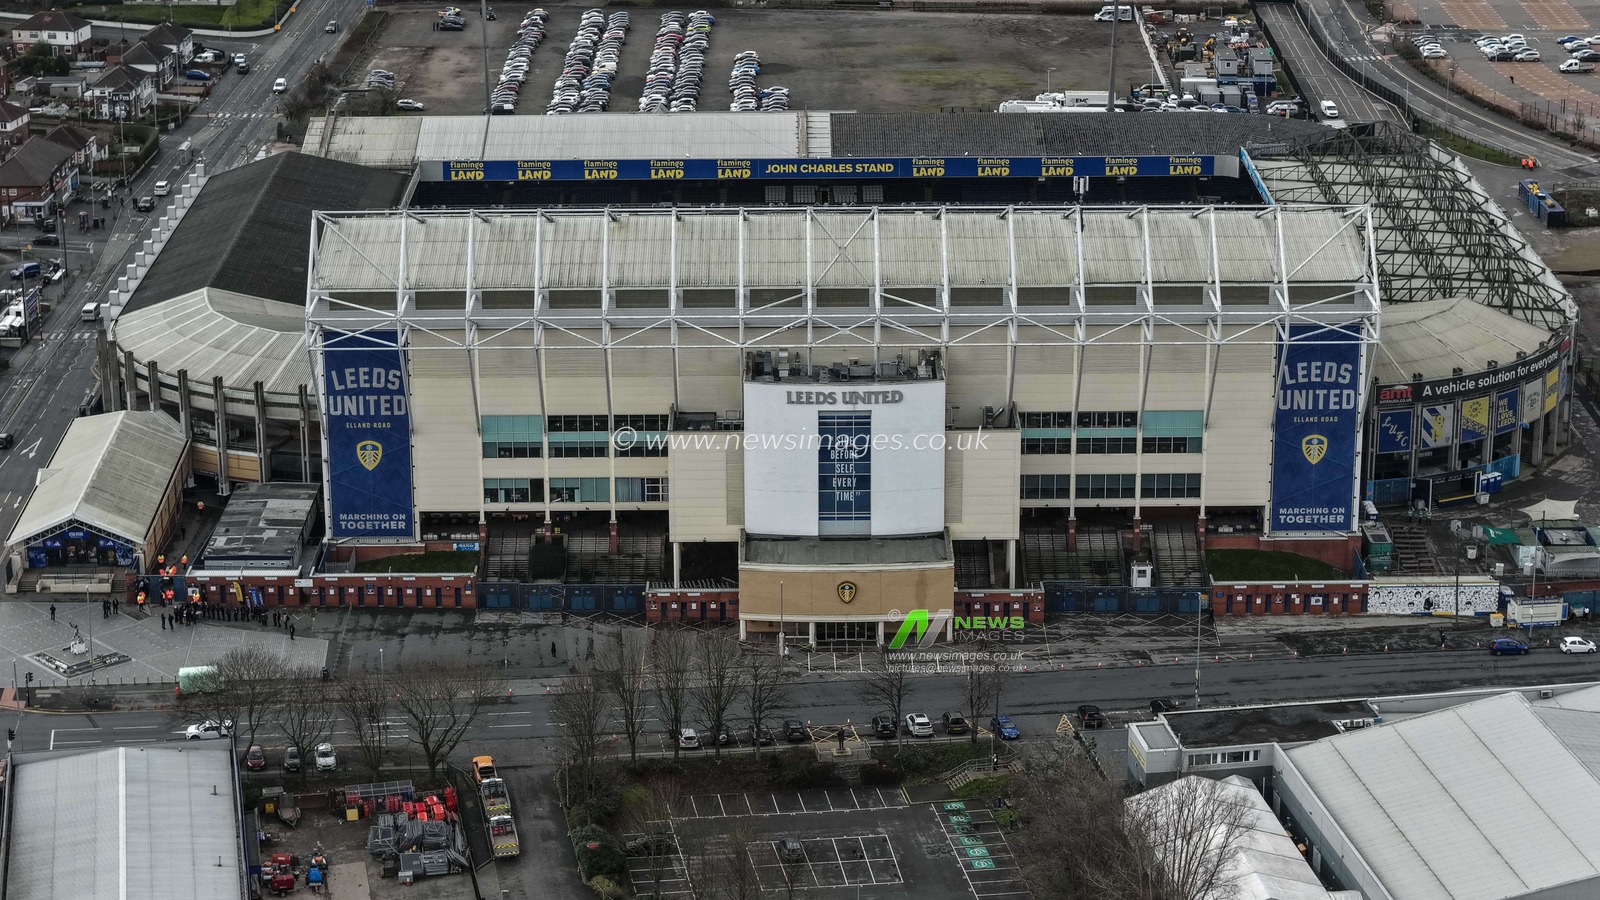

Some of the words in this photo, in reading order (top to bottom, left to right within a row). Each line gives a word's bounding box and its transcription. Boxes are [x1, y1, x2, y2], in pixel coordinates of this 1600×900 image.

[517, 160, 551, 169] flamingo
[584, 160, 617, 168] flamingo
[650, 159, 683, 168] flamingo
[717, 159, 750, 168] flamingo
[912, 158, 944, 166] flamingo
[977, 158, 1009, 166] flamingo
[1041, 157, 1073, 166] flamingo
[1105, 157, 1137, 165] flamingo
[1169, 156, 1201, 165] flamingo
[450, 161, 484, 170] flamingo
[766, 164, 797, 173] JOHN
[801, 164, 852, 172] CHARLES
[856, 164, 894, 172] STAND
[451, 170, 485, 180] LAND
[518, 170, 552, 179] LAND
[585, 170, 618, 179] LAND
[651, 169, 684, 178] LAND
[718, 169, 751, 178] LAND
[913, 167, 945, 177] LAND
[978, 167, 1010, 176] LAND
[1042, 167, 1074, 176] LAND
[1106, 166, 1138, 176] LAND
[1170, 166, 1202, 175] LAND
[1283, 362, 1352, 385] LEEDS
[1422, 385, 1432, 397] A
[1435, 380, 1476, 395] vehicle
[1478, 370, 1516, 388] solution
[1517, 366, 1529, 378] for
[1530, 351, 1559, 372] everyone
[331, 368, 401, 391] LEEDS
[786, 390, 838, 405] LEEDS
[841, 390, 904, 404] UNITED
[1380, 386, 1412, 400] amt
[1278, 389, 1355, 410] UNITED
[1499, 398, 1508, 406] WE
[329, 396, 406, 416] UNITED
[1498, 405, 1508, 414] ALL
[1498, 410, 1513, 420] LOVE
[1497, 416, 1516, 428] LEEDS
[830, 450, 858, 460] BEFORE
[836, 464, 856, 474] SELF,
[832, 478, 857, 488] EVERY
[1279, 515, 1344, 524] TOGETHER
[340, 522, 406, 530] TOGETHER
